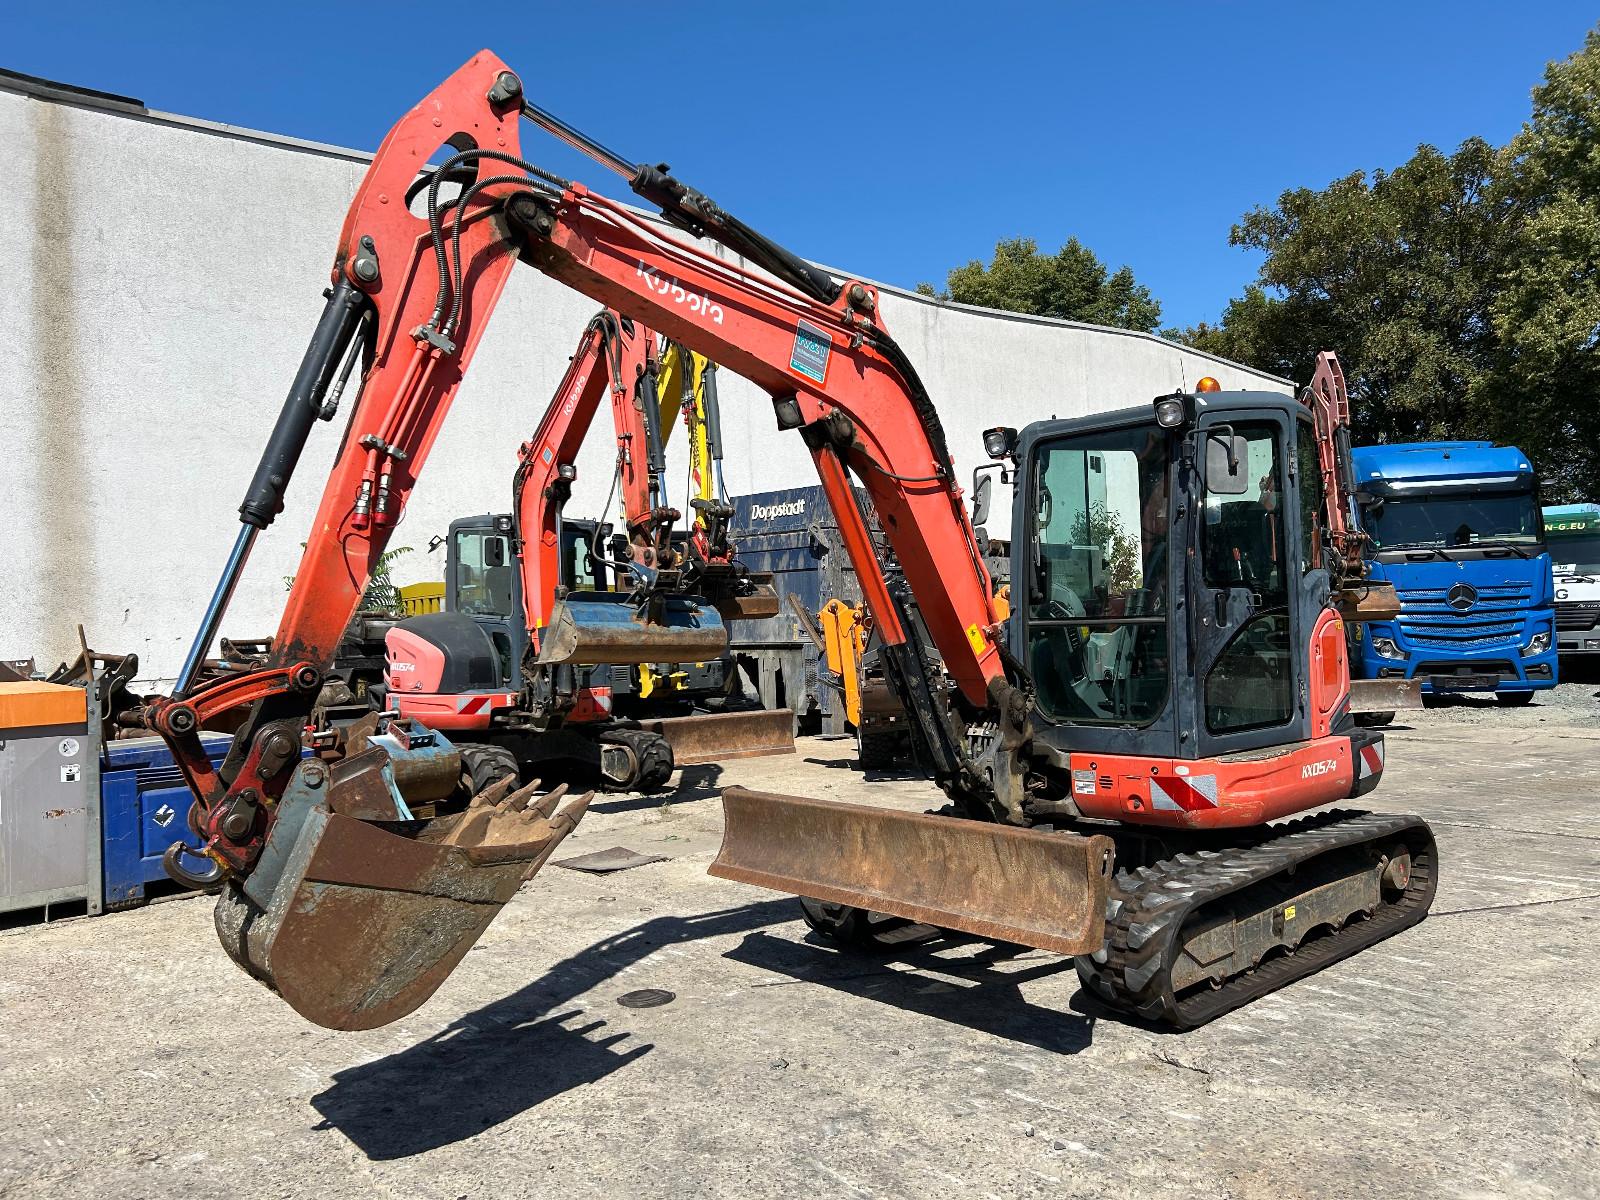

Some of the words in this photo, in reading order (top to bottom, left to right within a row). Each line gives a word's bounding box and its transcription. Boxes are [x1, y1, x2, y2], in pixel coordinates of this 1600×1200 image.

[636, 258, 724, 326] Kubota
[563, 375, 586, 416] Kubota
[751, 498, 806, 522] Doppstadt
